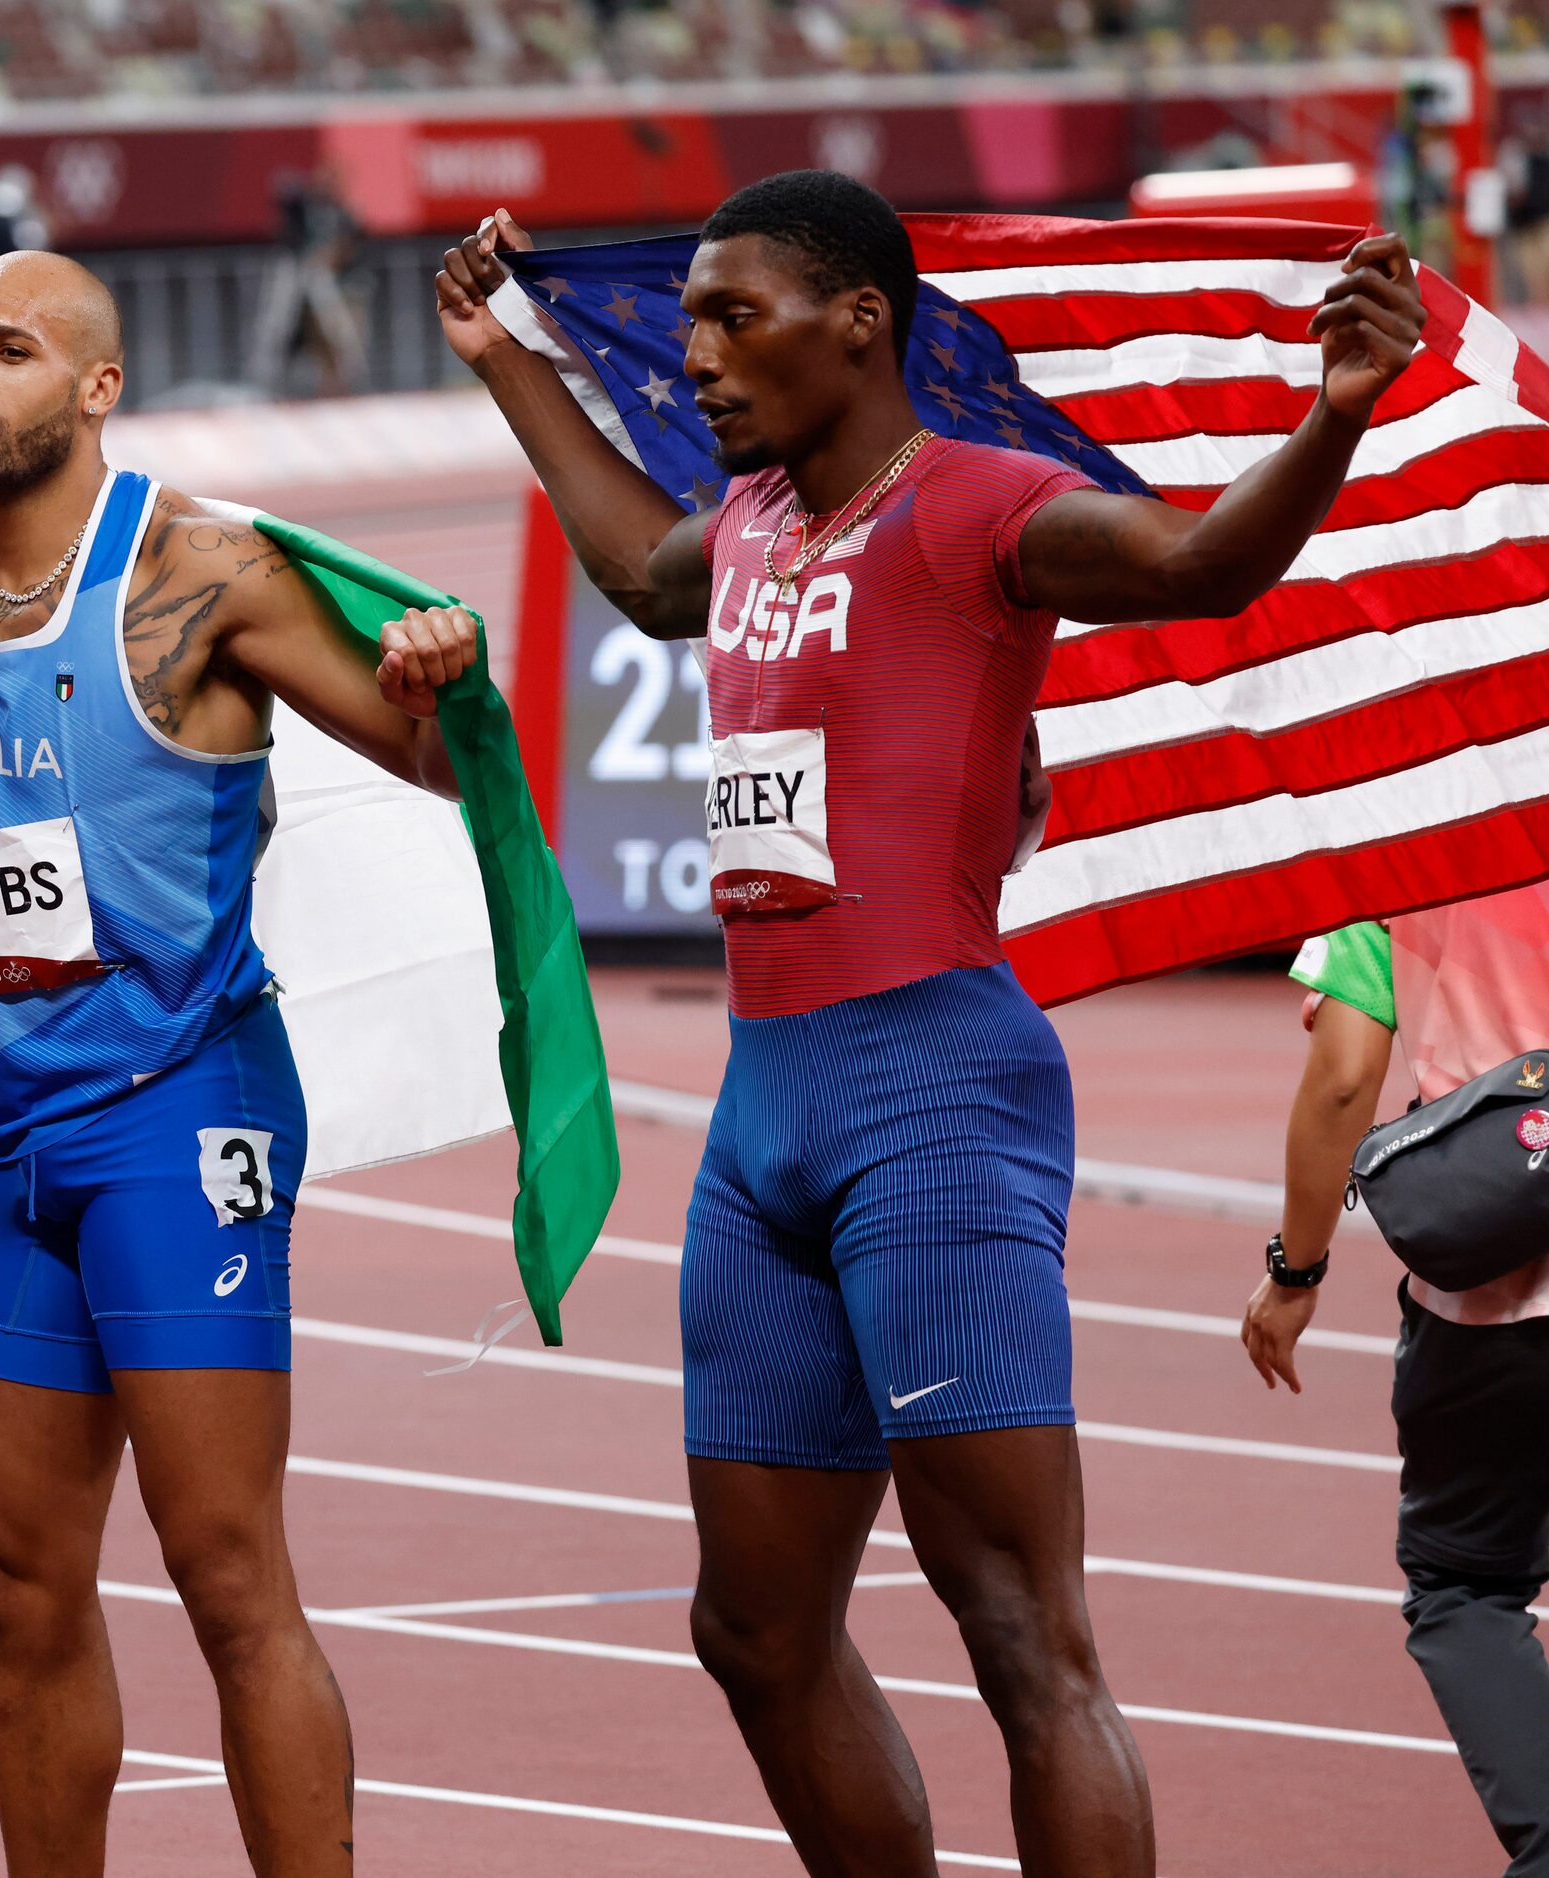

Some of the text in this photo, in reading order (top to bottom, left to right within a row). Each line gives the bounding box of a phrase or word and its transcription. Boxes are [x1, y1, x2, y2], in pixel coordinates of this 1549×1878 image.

[710, 566, 852, 662] USA
[1401, 1126, 1435, 1146] 2020
[220, 1138, 264, 1218] 3
